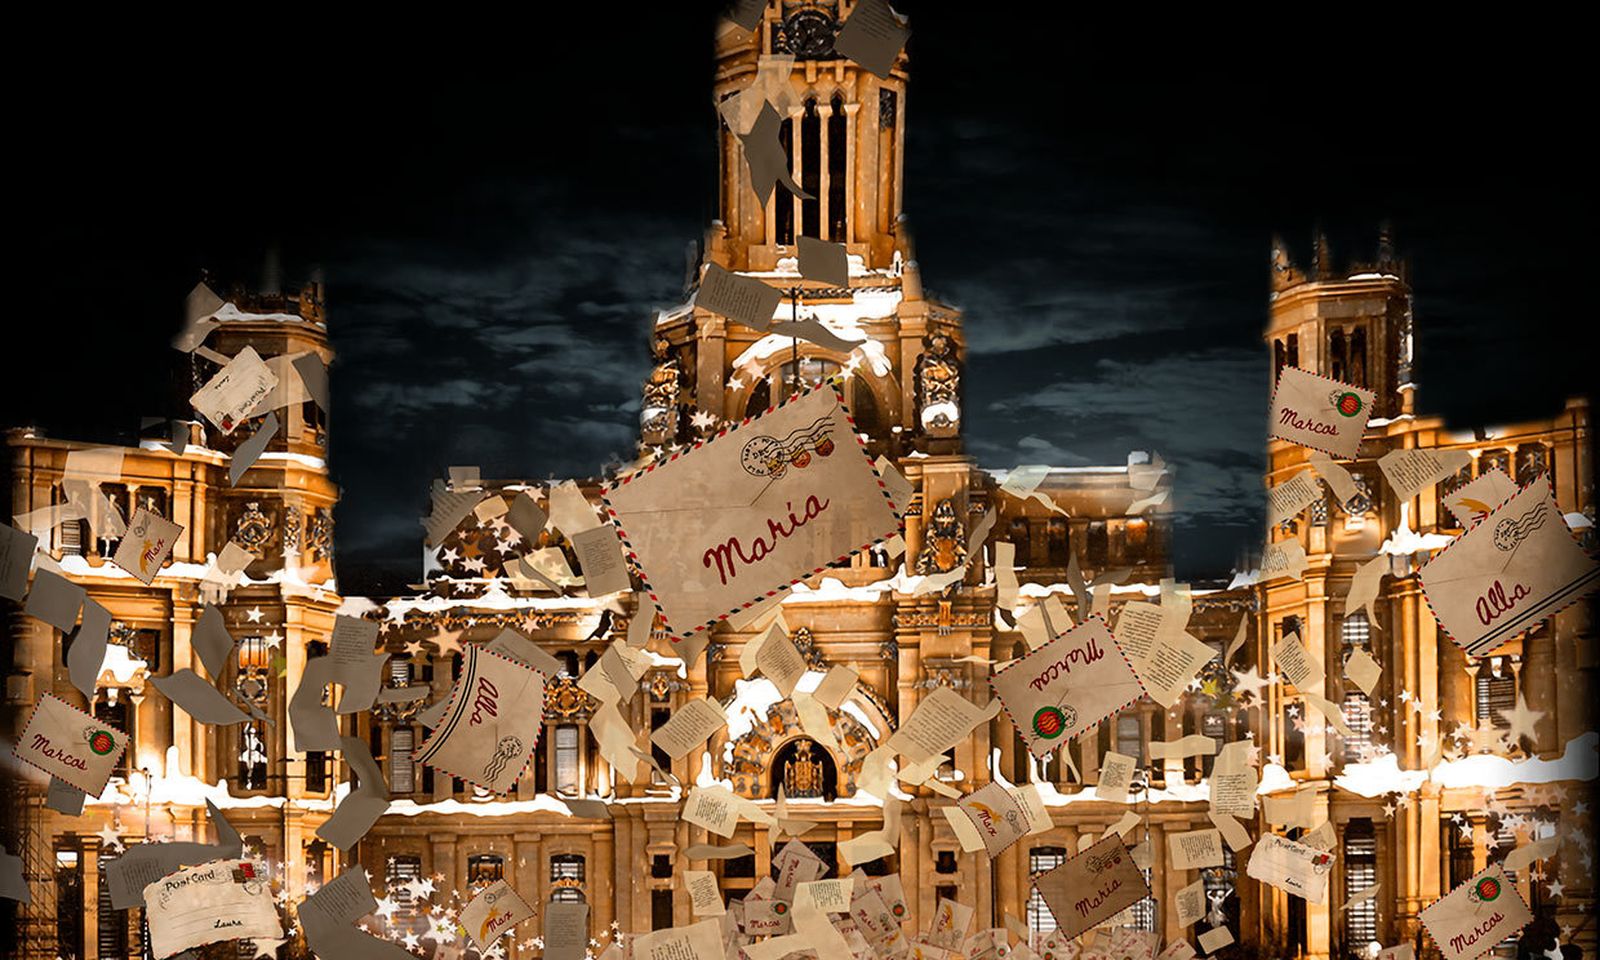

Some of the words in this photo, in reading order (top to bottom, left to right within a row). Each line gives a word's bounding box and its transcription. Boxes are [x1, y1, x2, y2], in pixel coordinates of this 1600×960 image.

[1279, 406, 1340, 436] Marcos
[143, 537, 165, 563] Max
[703, 493, 830, 586] María
[1476, 579, 1537, 626] Alba
[1029, 637, 1104, 691] Marcos
[468, 675, 500, 727] Alba
[30, 733, 88, 771] Marcos
[976, 809, 997, 837] Max
[164, 876, 191, 893] Post
[191, 869, 216, 884] Card
[213, 919, 244, 930] Laura
[485, 910, 513, 933] Max
[1449, 911, 1504, 954] Marcos
